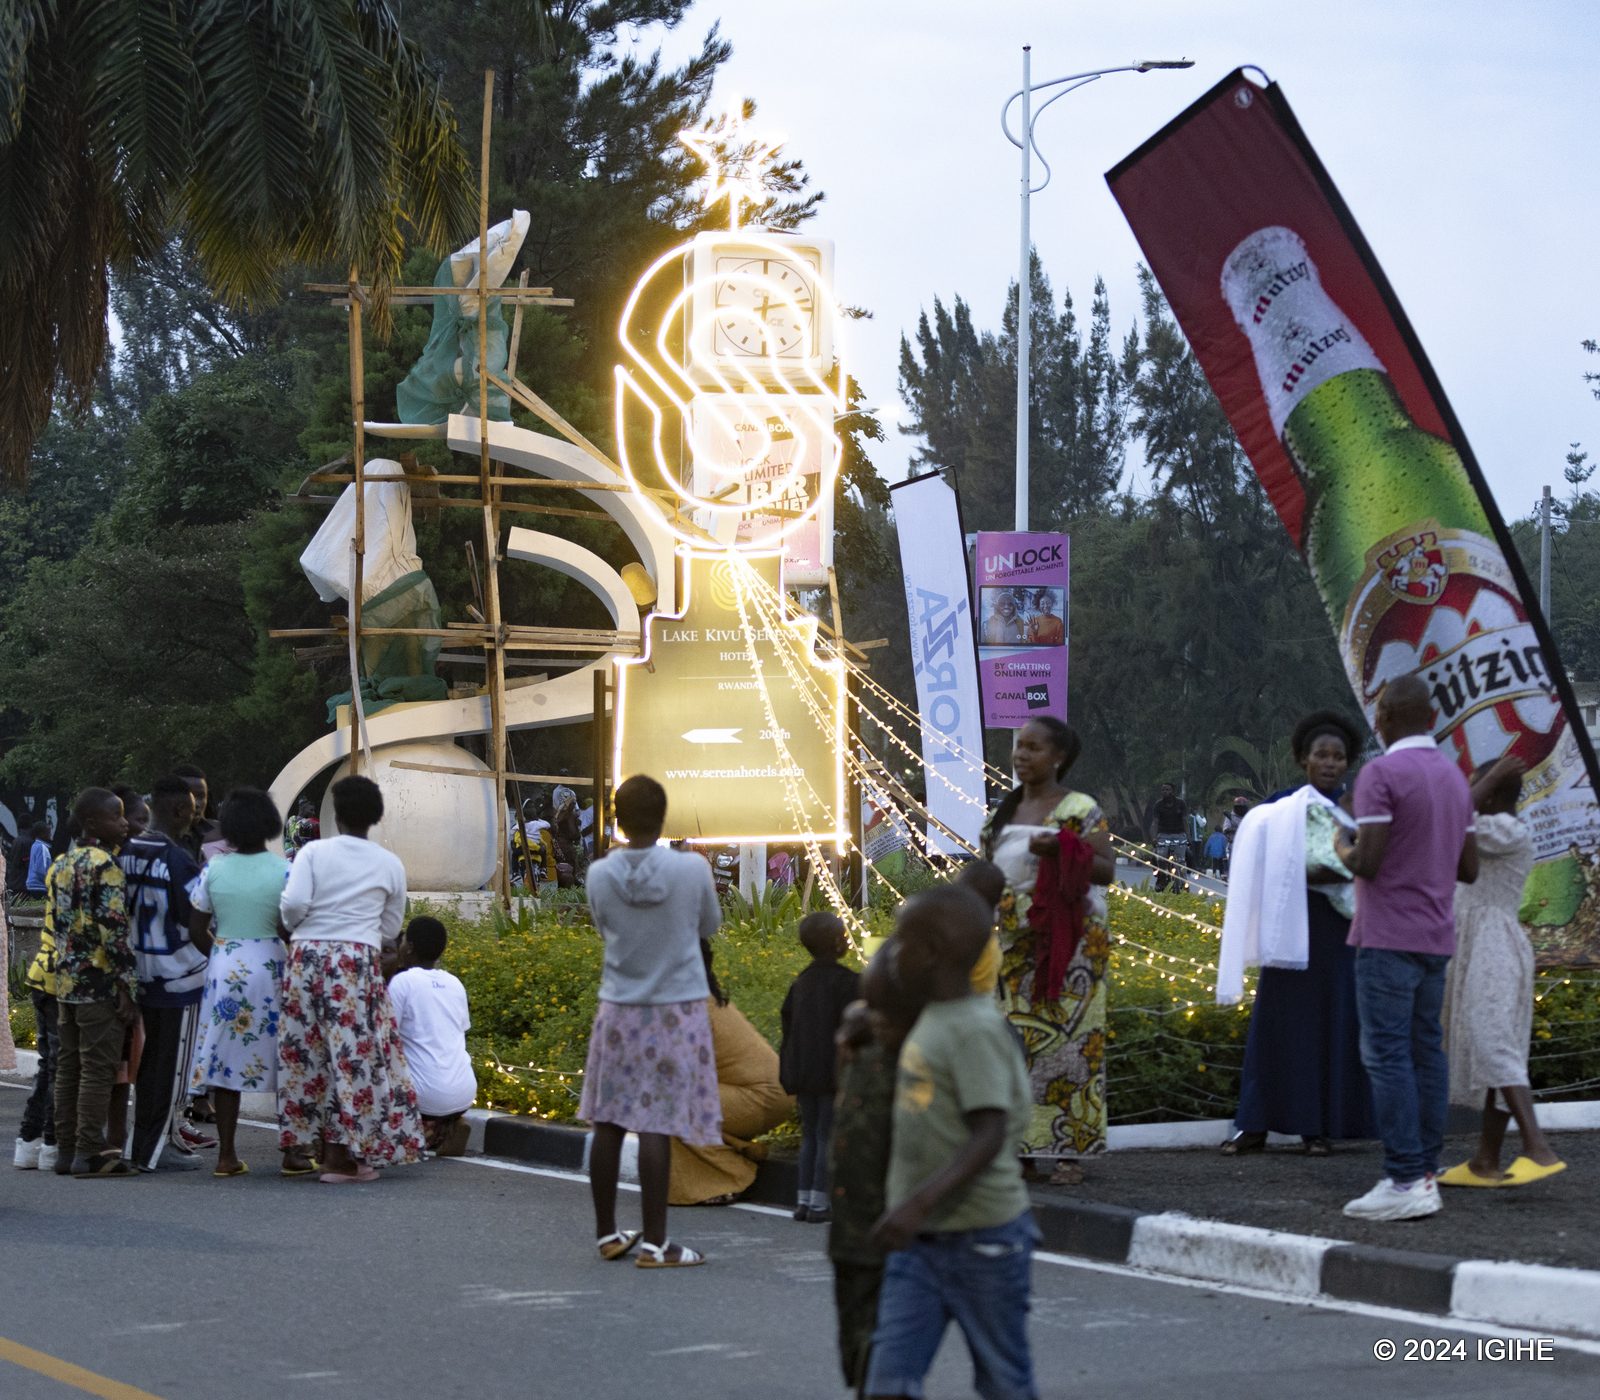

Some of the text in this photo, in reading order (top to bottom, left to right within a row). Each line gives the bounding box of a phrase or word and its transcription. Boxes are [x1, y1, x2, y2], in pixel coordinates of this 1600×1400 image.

[984, 544, 1063, 573] UNLOCK
[985, 561, 1064, 581] UNFORGETTABLE MOMENTS
[662, 629, 699, 642] LAKE
[705, 628, 741, 641] KIVU
[994, 662, 1051, 670] BY CHATTING
[1029, 670, 1051, 678] WITH
[664, 765, 805, 779] www.serenahotels.com
